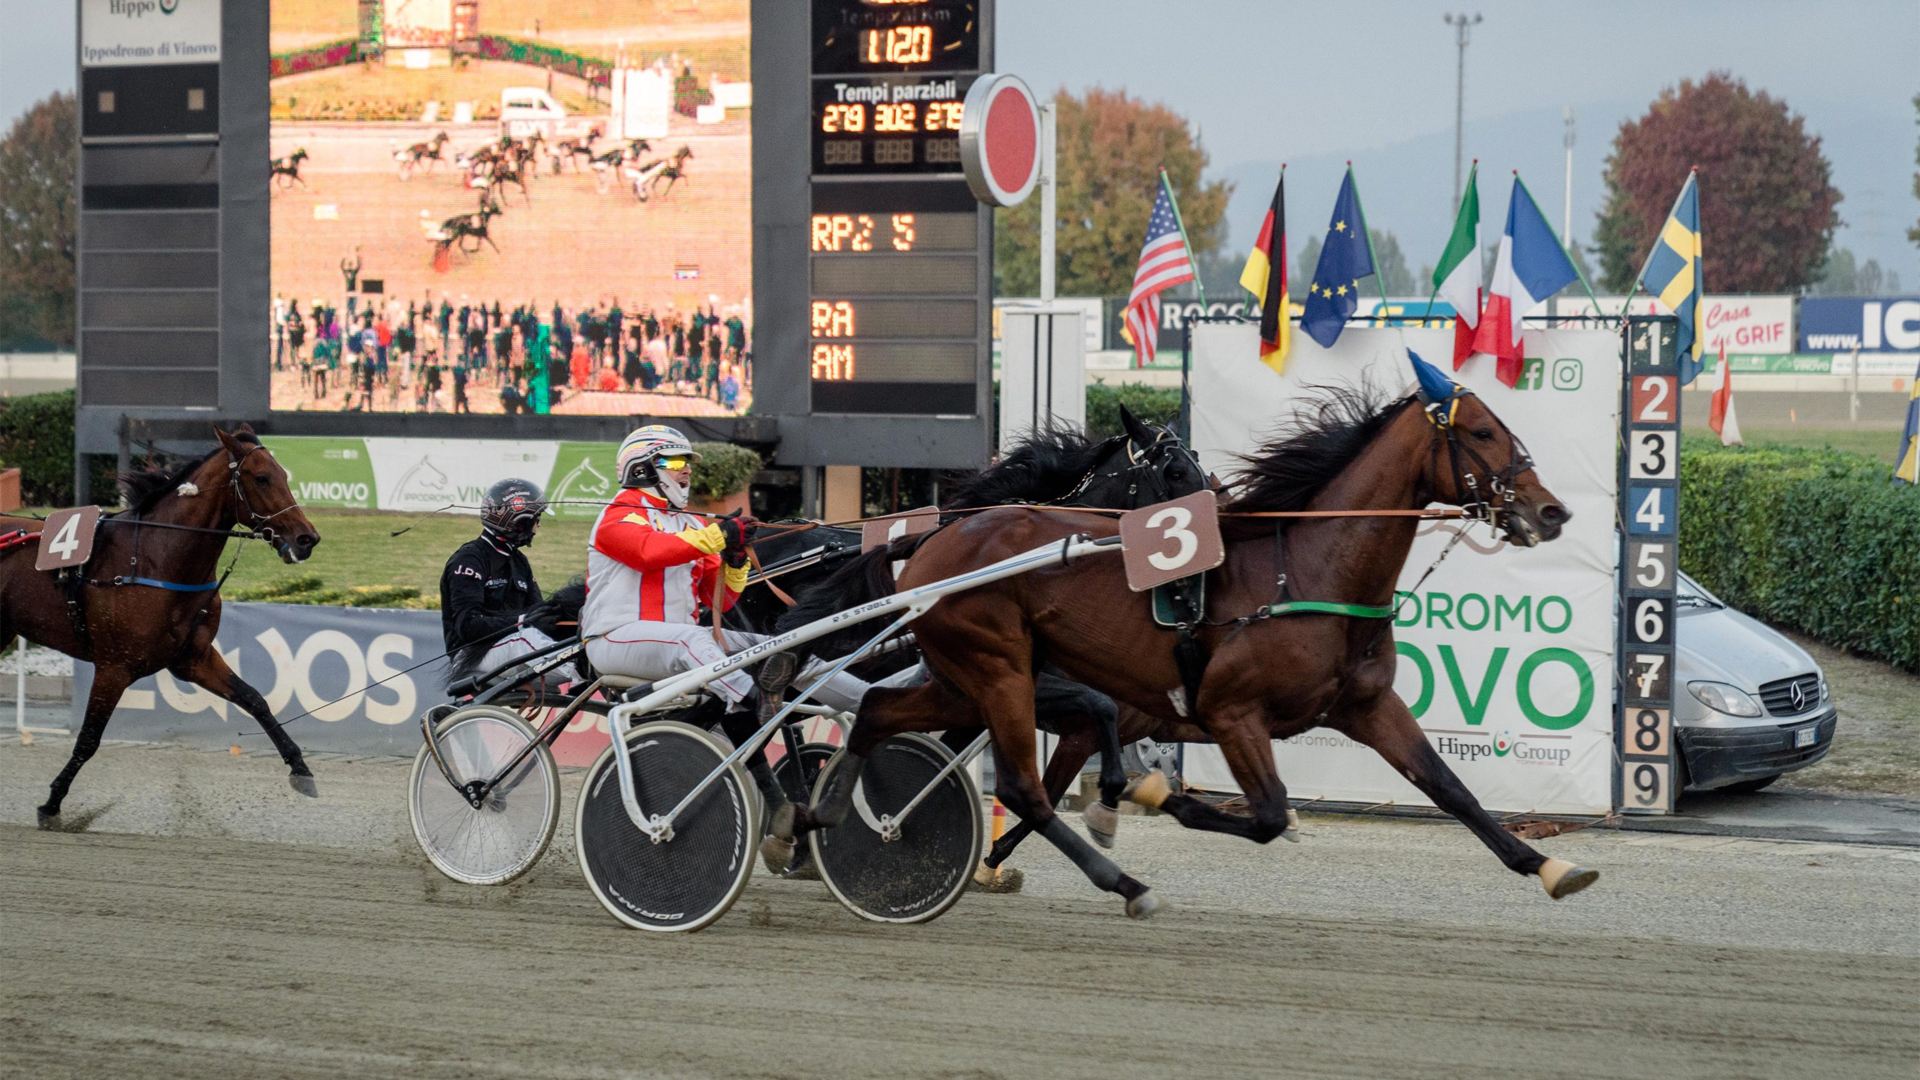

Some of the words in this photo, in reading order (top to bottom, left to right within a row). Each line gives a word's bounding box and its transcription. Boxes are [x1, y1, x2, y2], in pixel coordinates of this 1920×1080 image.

[109, 0, 156, 18] Hippo
[84, 44, 154, 61] Ippodromo
[158, 42, 170, 56] di
[174, 42, 217, 56] Vinovo
[834, 83, 888, 104] Tempi
[892, 80, 956, 103] parziali
[822, 104, 865, 132] 279
[812, 215, 874, 251] RP2
[892, 213, 915, 250] 5
[812, 302, 855, 337] RA
[1706, 303, 1751, 330] Casa
[1735, 322, 1784, 346] GRIF
[812, 344, 855, 381] AM
[1647, 321, 1661, 366] 1
[1640, 376, 1669, 420] 2
[1640, 433, 1666, 475] 3
[299, 481, 369, 501] VINOVO
[1635, 488, 1665, 532] 4
[48, 513, 82, 560] 4
[1145, 506, 1198, 571] 3
[1636, 543, 1666, 588] 5
[1634, 599, 1664, 643] 6
[712, 639, 778, 673] CUSTOM
[1635, 654, 1665, 698] 7
[1634, 709, 1661, 752] 8
[1438, 737, 1491, 761] Hippo
[1513, 742, 1571, 766] Group
[1633, 764, 1660, 805] 9
